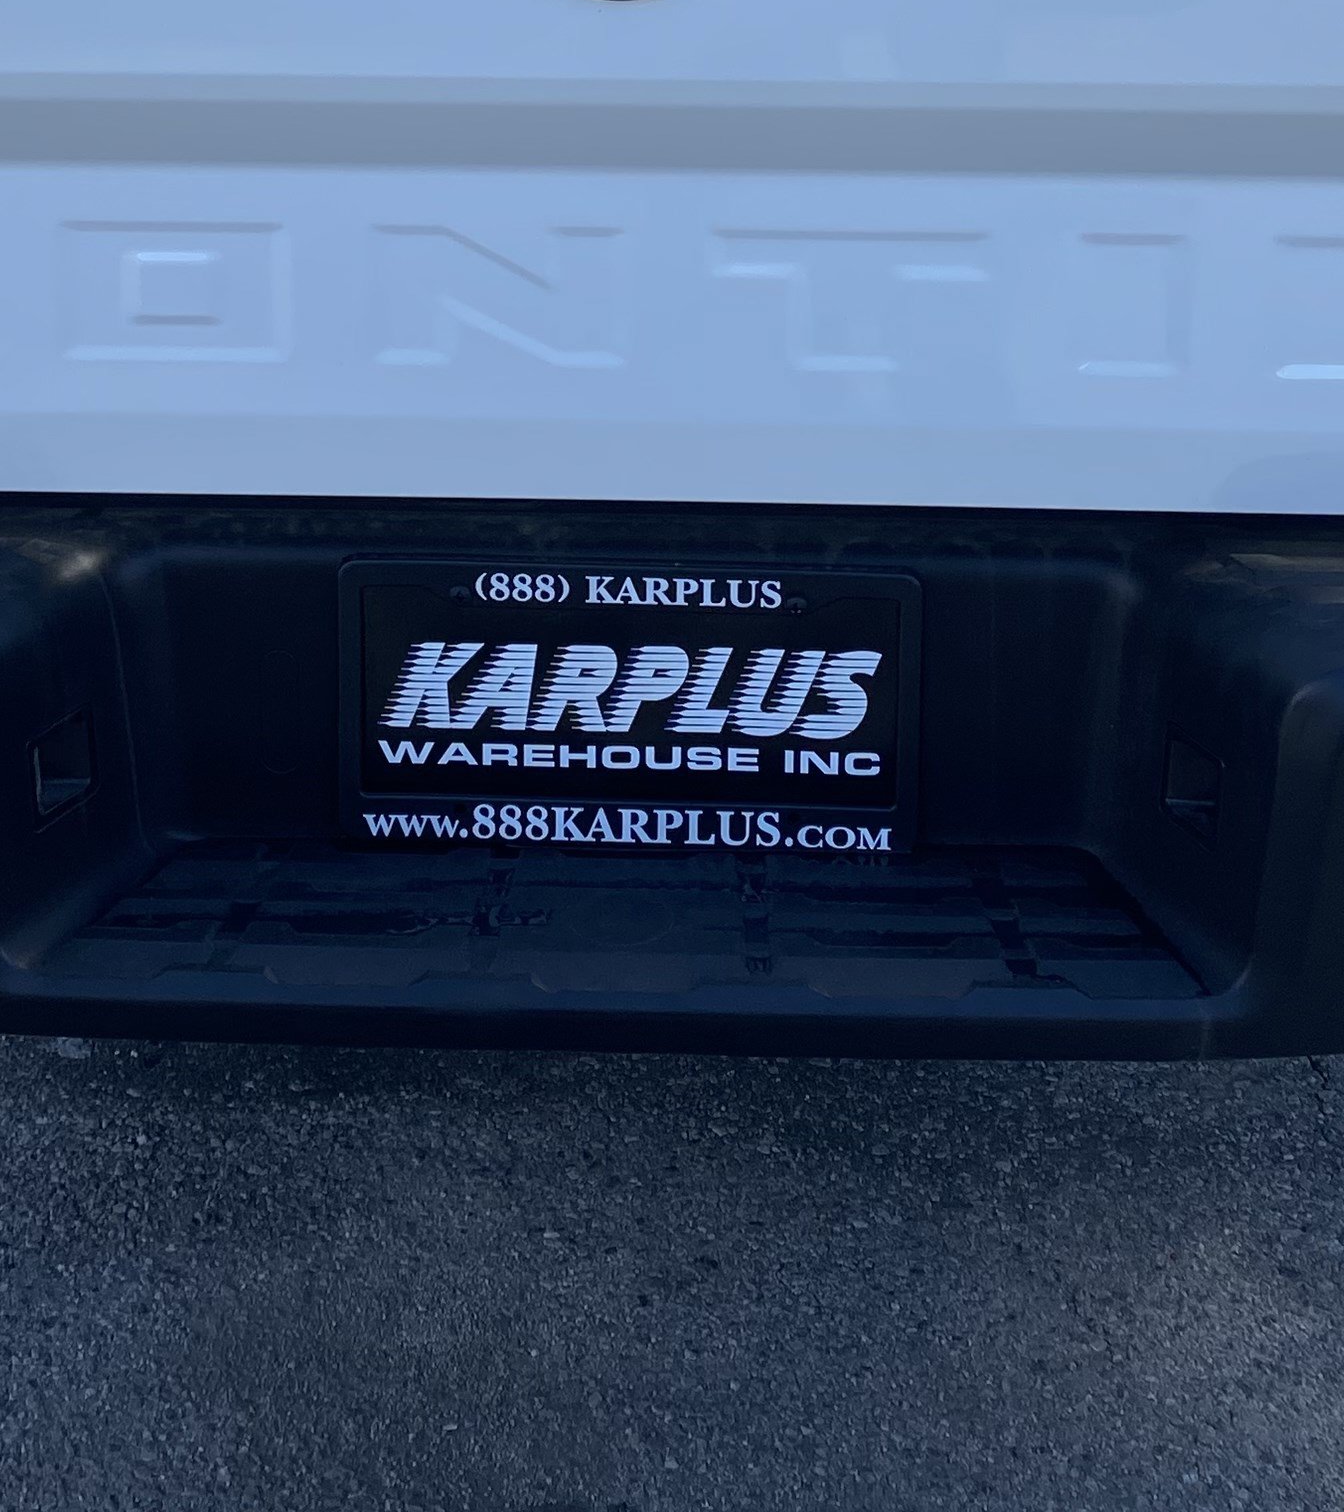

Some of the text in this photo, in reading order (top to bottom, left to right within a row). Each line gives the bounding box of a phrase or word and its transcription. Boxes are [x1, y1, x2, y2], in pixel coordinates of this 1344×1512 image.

[475, 572, 782, 609] (888) KARPLUS
[377, 642, 883, 740] KARPLUS
[377, 739, 881, 776] WAREHOUSE INC
